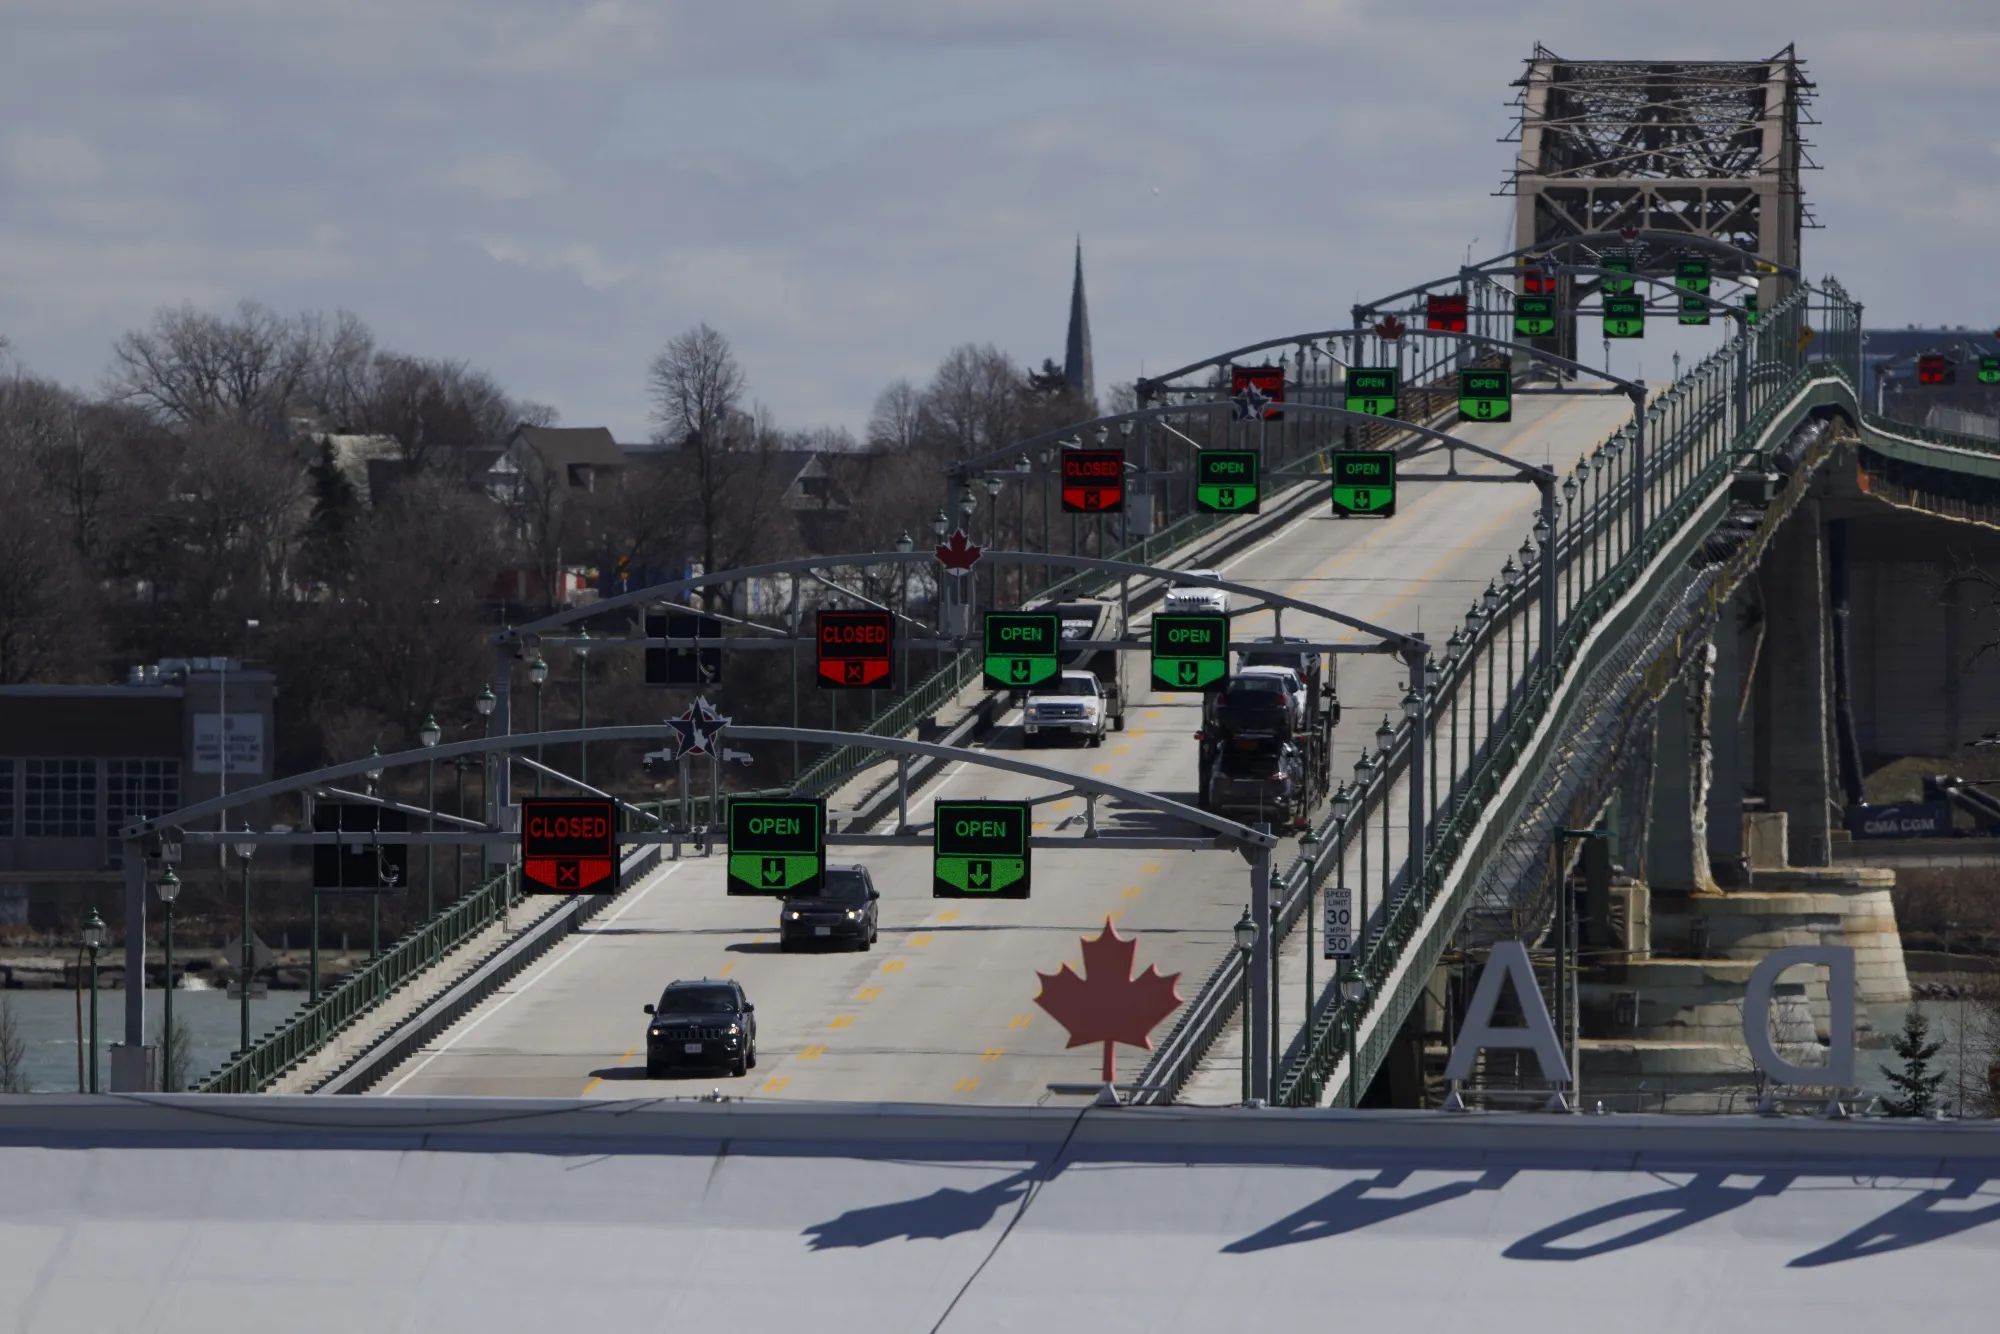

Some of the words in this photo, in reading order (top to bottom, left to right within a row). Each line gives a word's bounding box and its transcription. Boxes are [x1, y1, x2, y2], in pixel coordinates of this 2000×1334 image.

[1612, 302, 1635, 313] OPEN
[1355, 376, 1387, 389] OPEN
[1470, 378, 1500, 390] OPEN
[1066, 460, 1119, 477] CLOSED
[1209, 461, 1245, 474] OPEN
[1346, 461, 1380, 475] OPEN
[822, 624, 886, 644] CLOSED
[1000, 626, 1043, 642] OPEN
[1167, 628, 1211, 644] OPEN
[529, 816, 607, 839] CLOSED
[748, 816, 801, 836] OPEN
[955, 819, 1007, 838] OPEN
[1864, 820, 1899, 833] CMA
[1900, 818, 1935, 832] CGM
[1326, 909, 1349, 925] 30
[1328, 938, 1347, 951] 50
